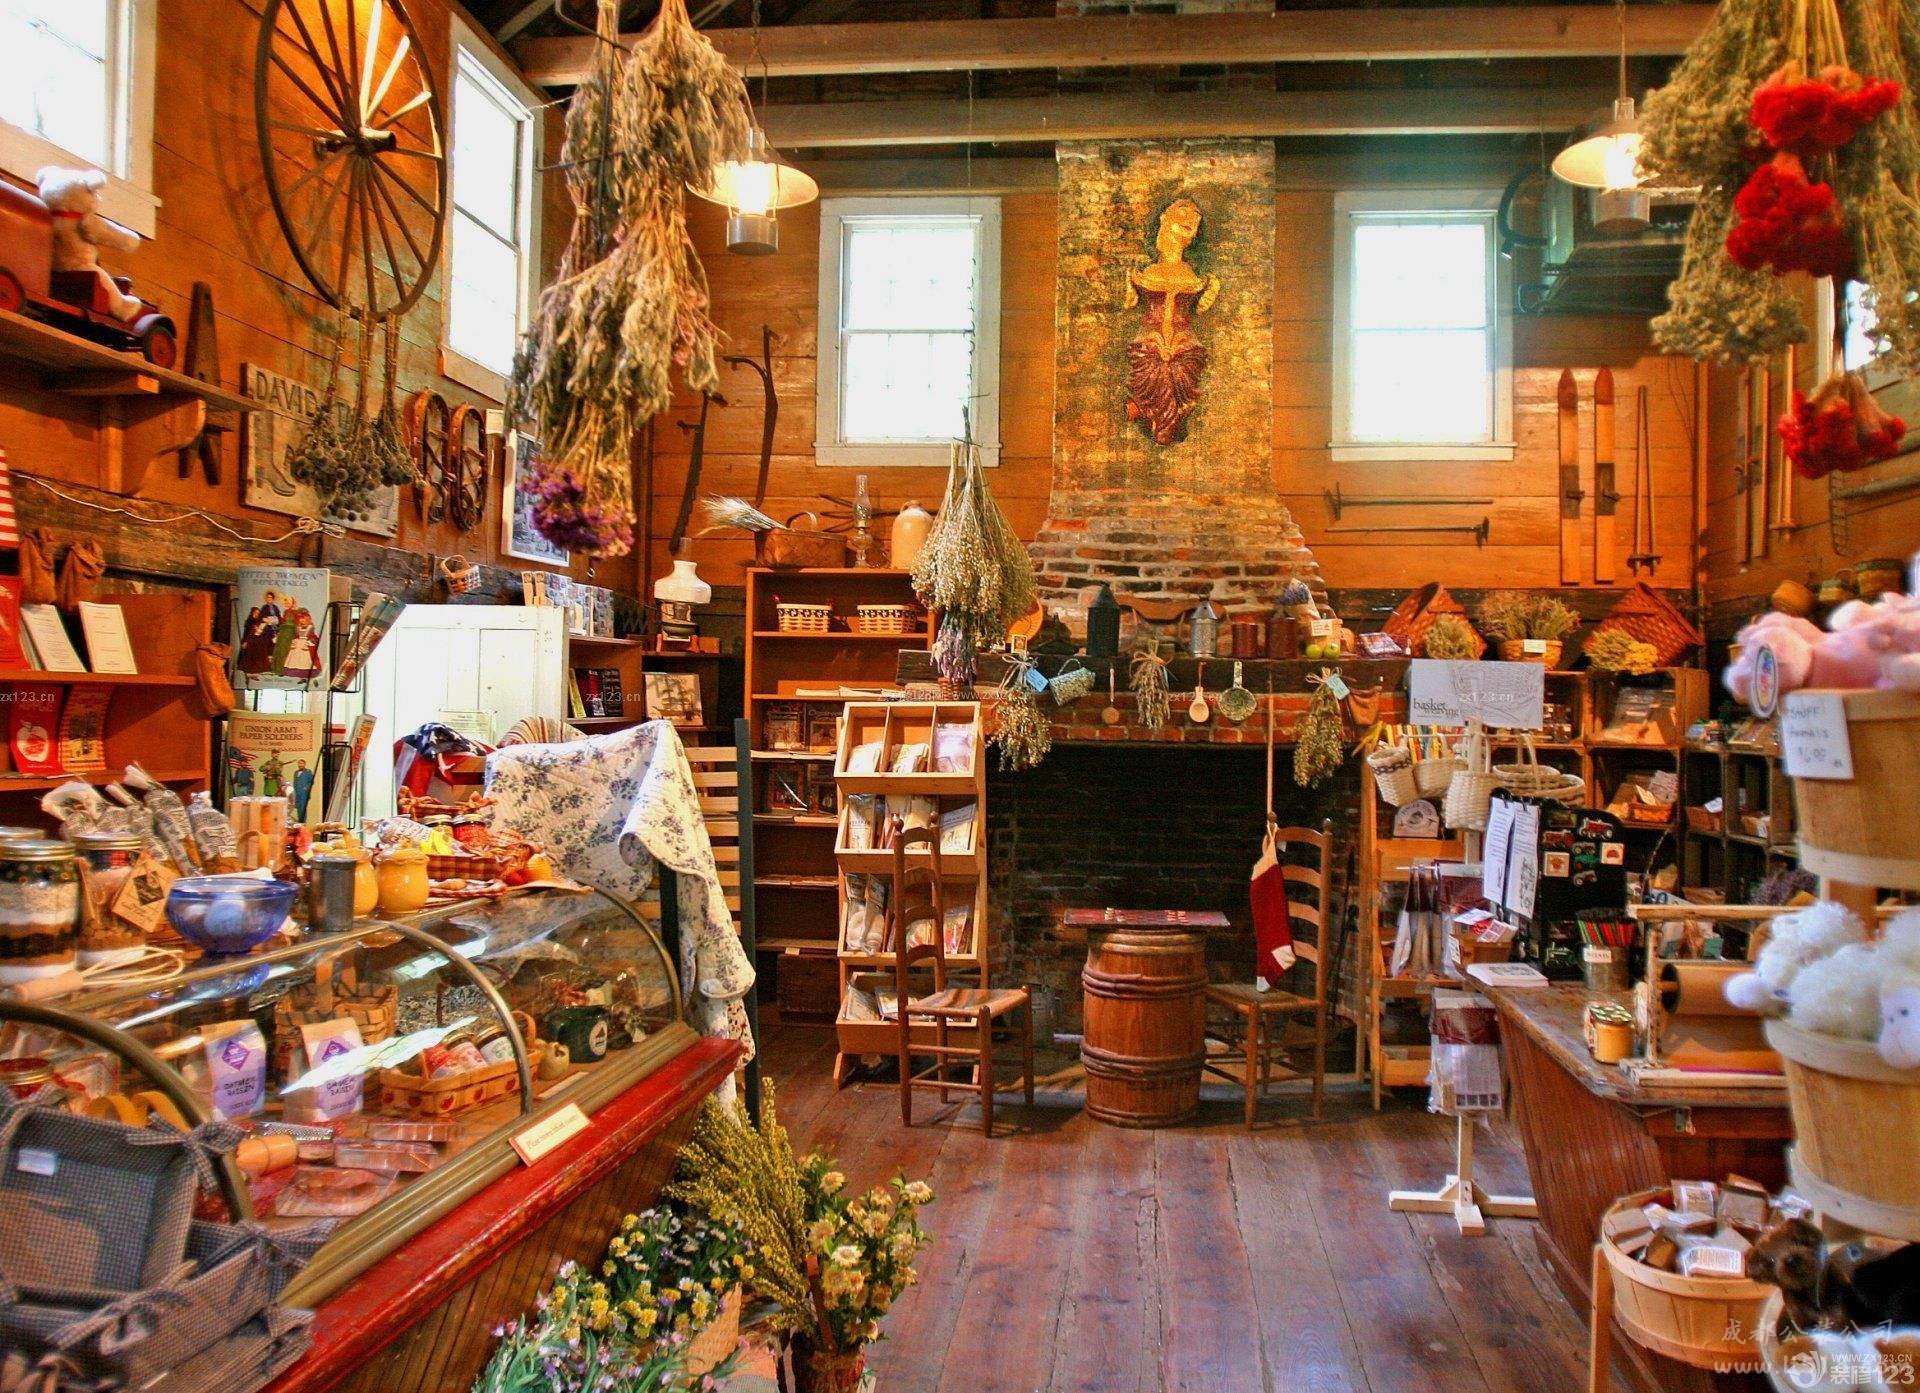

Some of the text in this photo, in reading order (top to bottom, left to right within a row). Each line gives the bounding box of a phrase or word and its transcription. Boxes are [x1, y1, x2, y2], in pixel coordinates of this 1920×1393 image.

[1413, 698, 1447, 710] basket
[273, 726, 298, 734] ARMY
[240, 732, 303, 741] PAPER SOLDIERS
